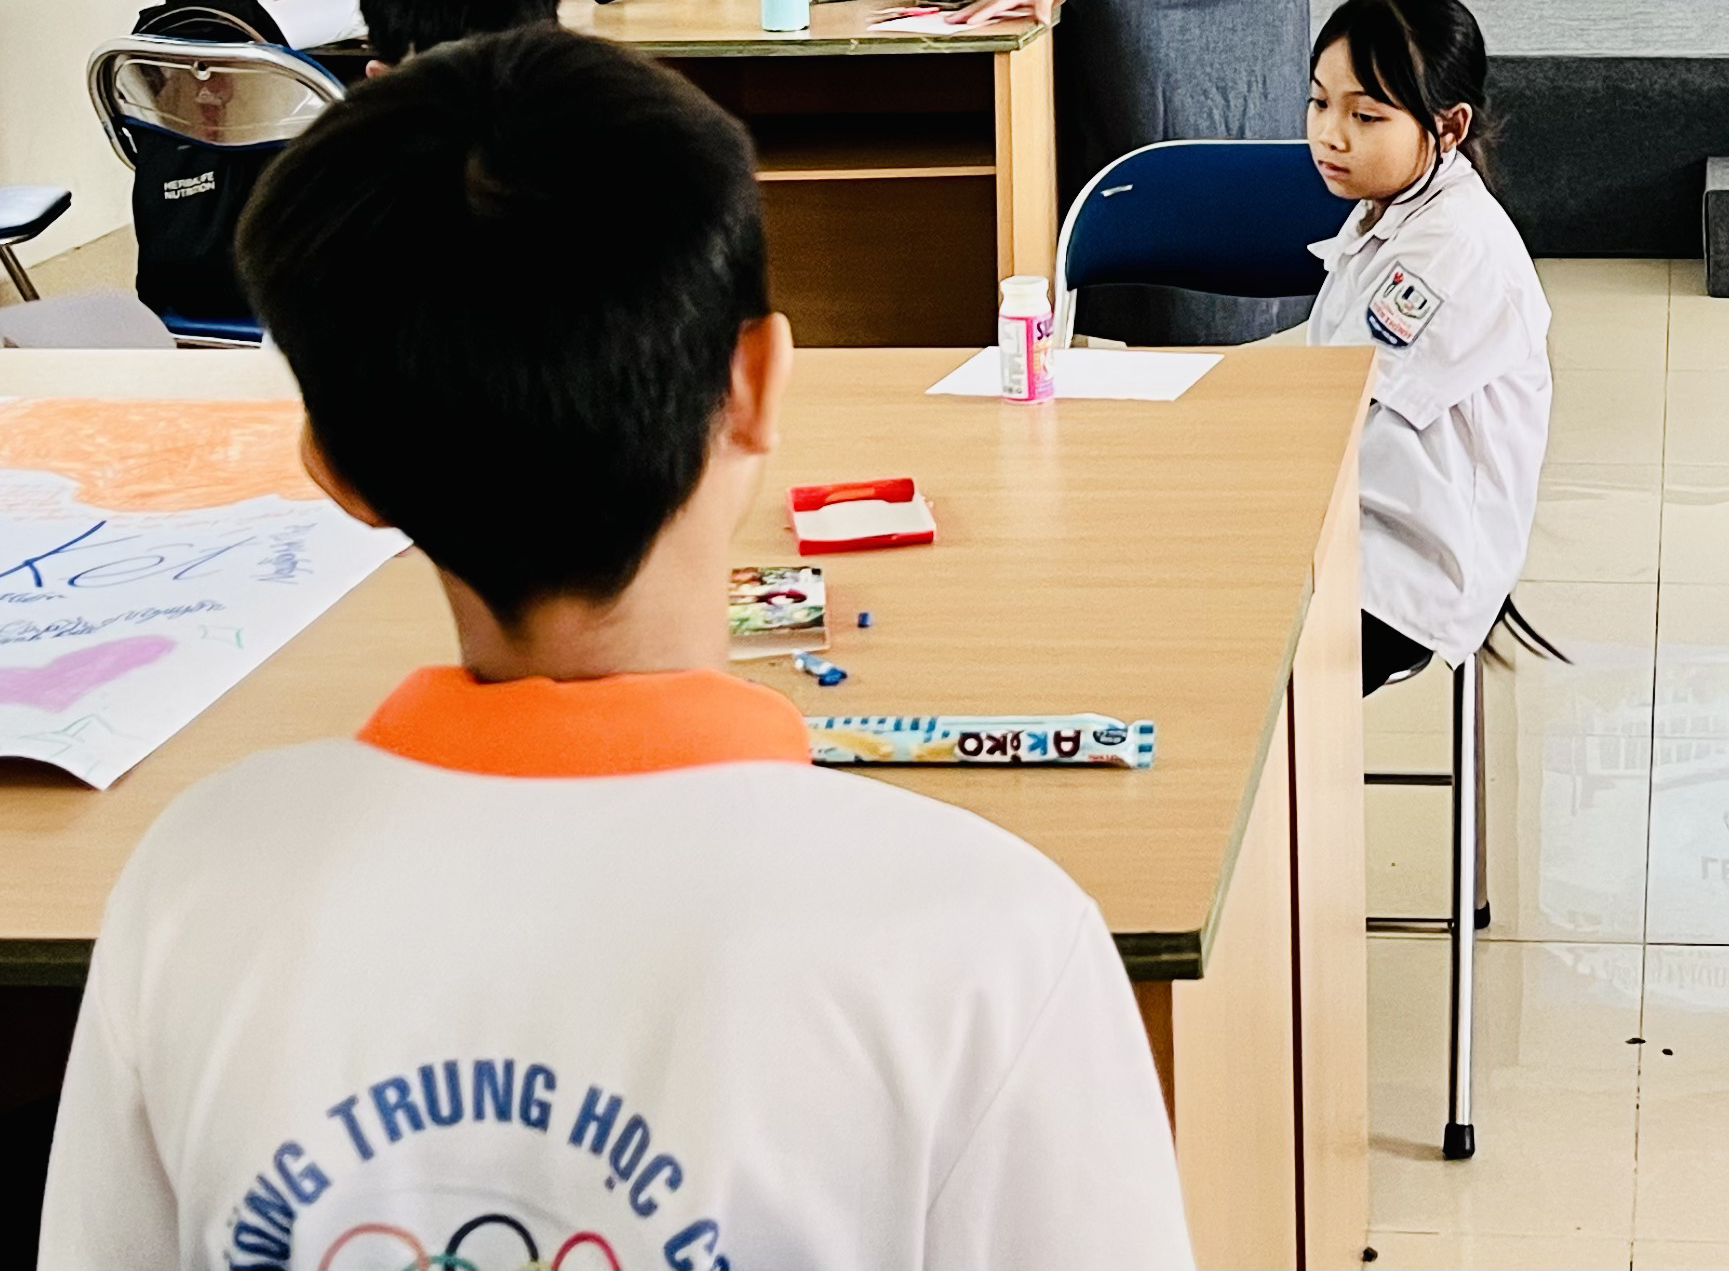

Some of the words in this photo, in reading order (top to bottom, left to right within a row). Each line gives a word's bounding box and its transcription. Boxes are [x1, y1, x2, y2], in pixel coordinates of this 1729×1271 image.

[326, 1058, 557, 1163] TRUNG
[567, 1084, 684, 1219] HỌC
[663, 1219, 730, 1271] C
